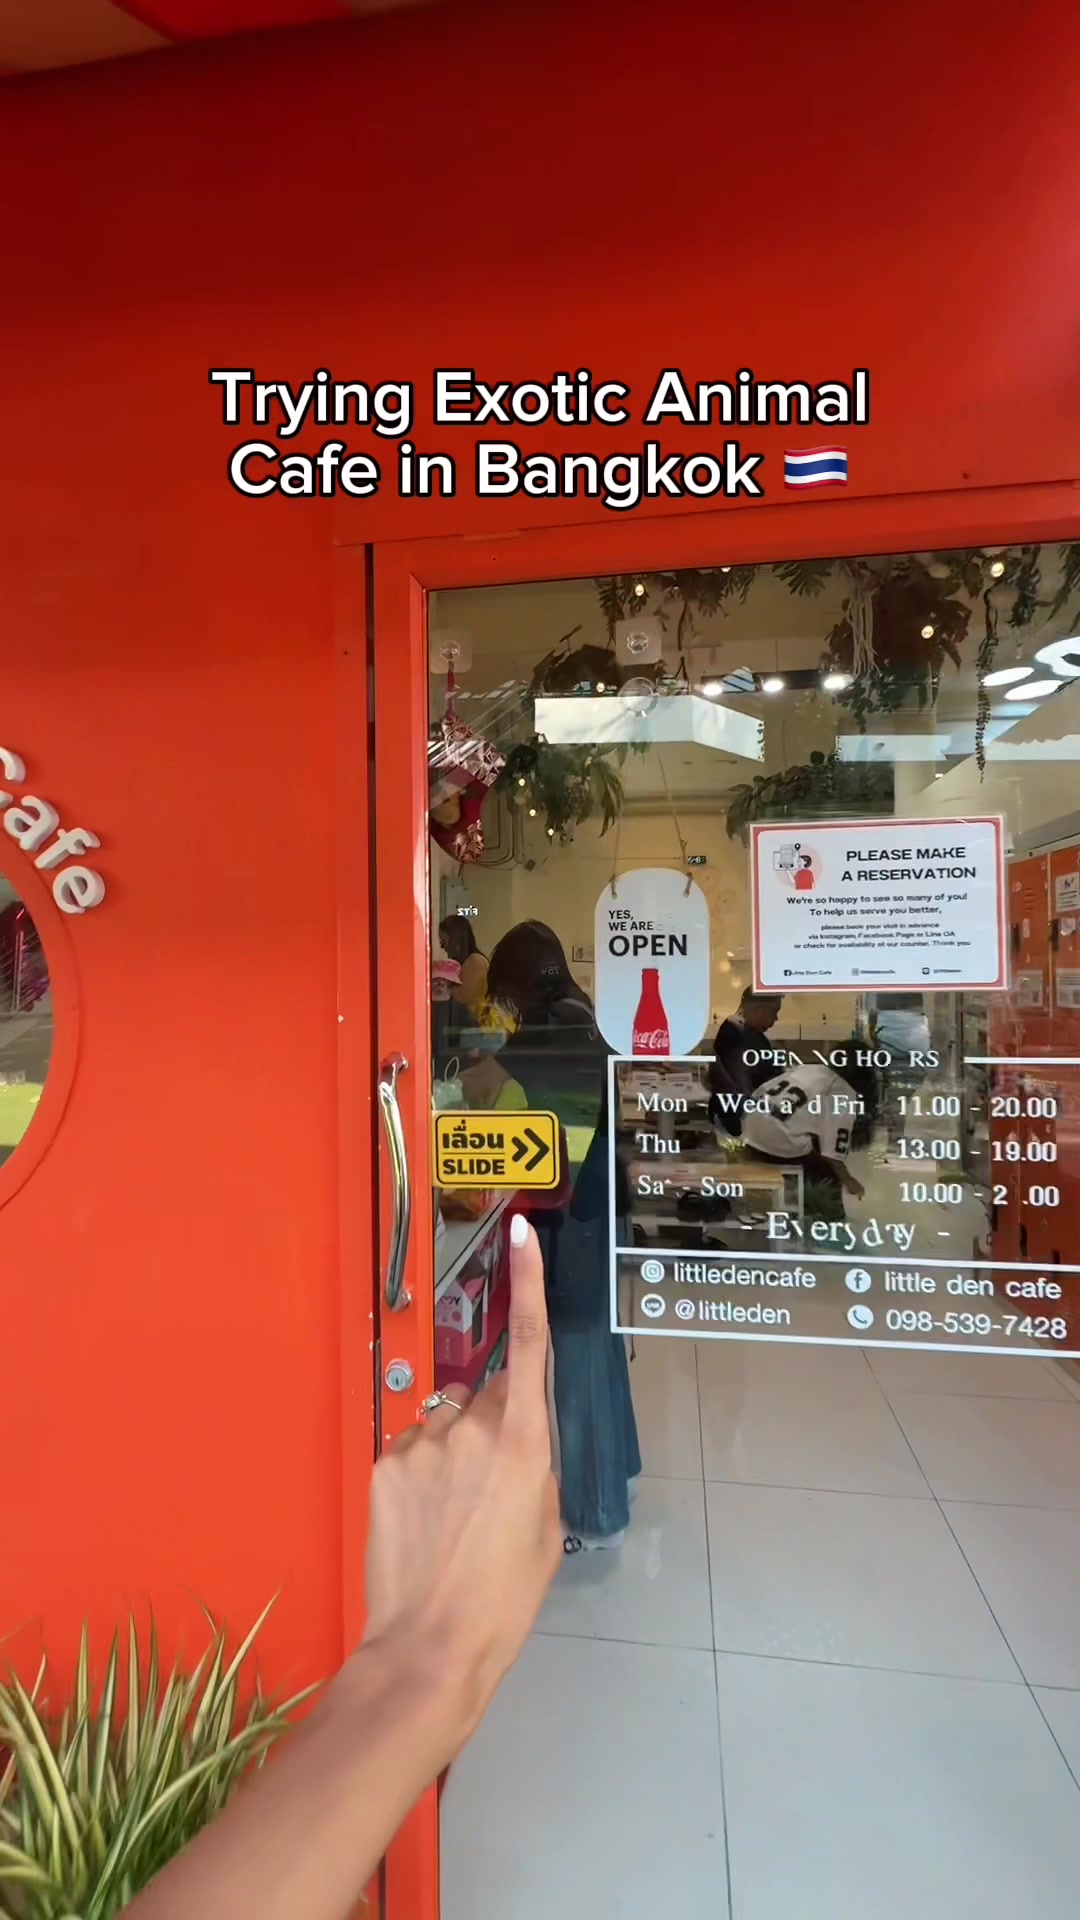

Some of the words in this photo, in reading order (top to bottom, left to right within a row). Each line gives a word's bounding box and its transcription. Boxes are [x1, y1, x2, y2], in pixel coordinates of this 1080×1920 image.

[846, 848, 912, 861] PLEASE
[916, 846, 966, 859] MAKE
[841, 870, 853, 882] A
[857, 867, 976, 881] RESERVATION
[786, 896, 813, 904] We're
[828, 896, 858, 905] happy
[906, 895, 932, 903] many
[934, 892, 945, 901] of
[947, 892, 968, 902] you!
[608, 909, 634, 920] YES,
[809, 908, 822, 916] To
[823, 908, 844, 917] help
[889, 908, 907, 916] you
[908, 906, 942, 915] better,
[608, 922, 627, 931] WE
[630, 921, 654, 931] ARE
[608, 934, 688, 957] OPEN
[856, 1049, 940, 1068] HORS
[636, 1092, 688, 1113] Mon
[716, 1092, 771, 1114] Wed
[780, 1094, 822, 1114] ad
[831, 1094, 865, 1115] Fri
[897, 1095, 961, 1117] 11.00
[991, 1096, 1057, 1118] 20.00
[442, 1119, 504, 1149] เลื่อน
[636, 1133, 680, 1154] Thu
[897, 1138, 961, 1160] 13.00
[991, 1140, 1057, 1162] 19.00
[442, 1158, 505, 1175] SLIDE
[637, 1174, 672, 1195] Sa
[899, 1182, 962, 1203] 10.00
[992, 1184, 1060, 1207] 2.00
[673, 1262, 817, 1289] littledencafe
[884, 1270, 937, 1293] little
[946, 1274, 995, 1296] den
[1005, 1277, 1062, 1299] cafe
[675, 1299, 791, 1325] @littleden
[886, 1308, 1068, 1339] 098-539-7428
